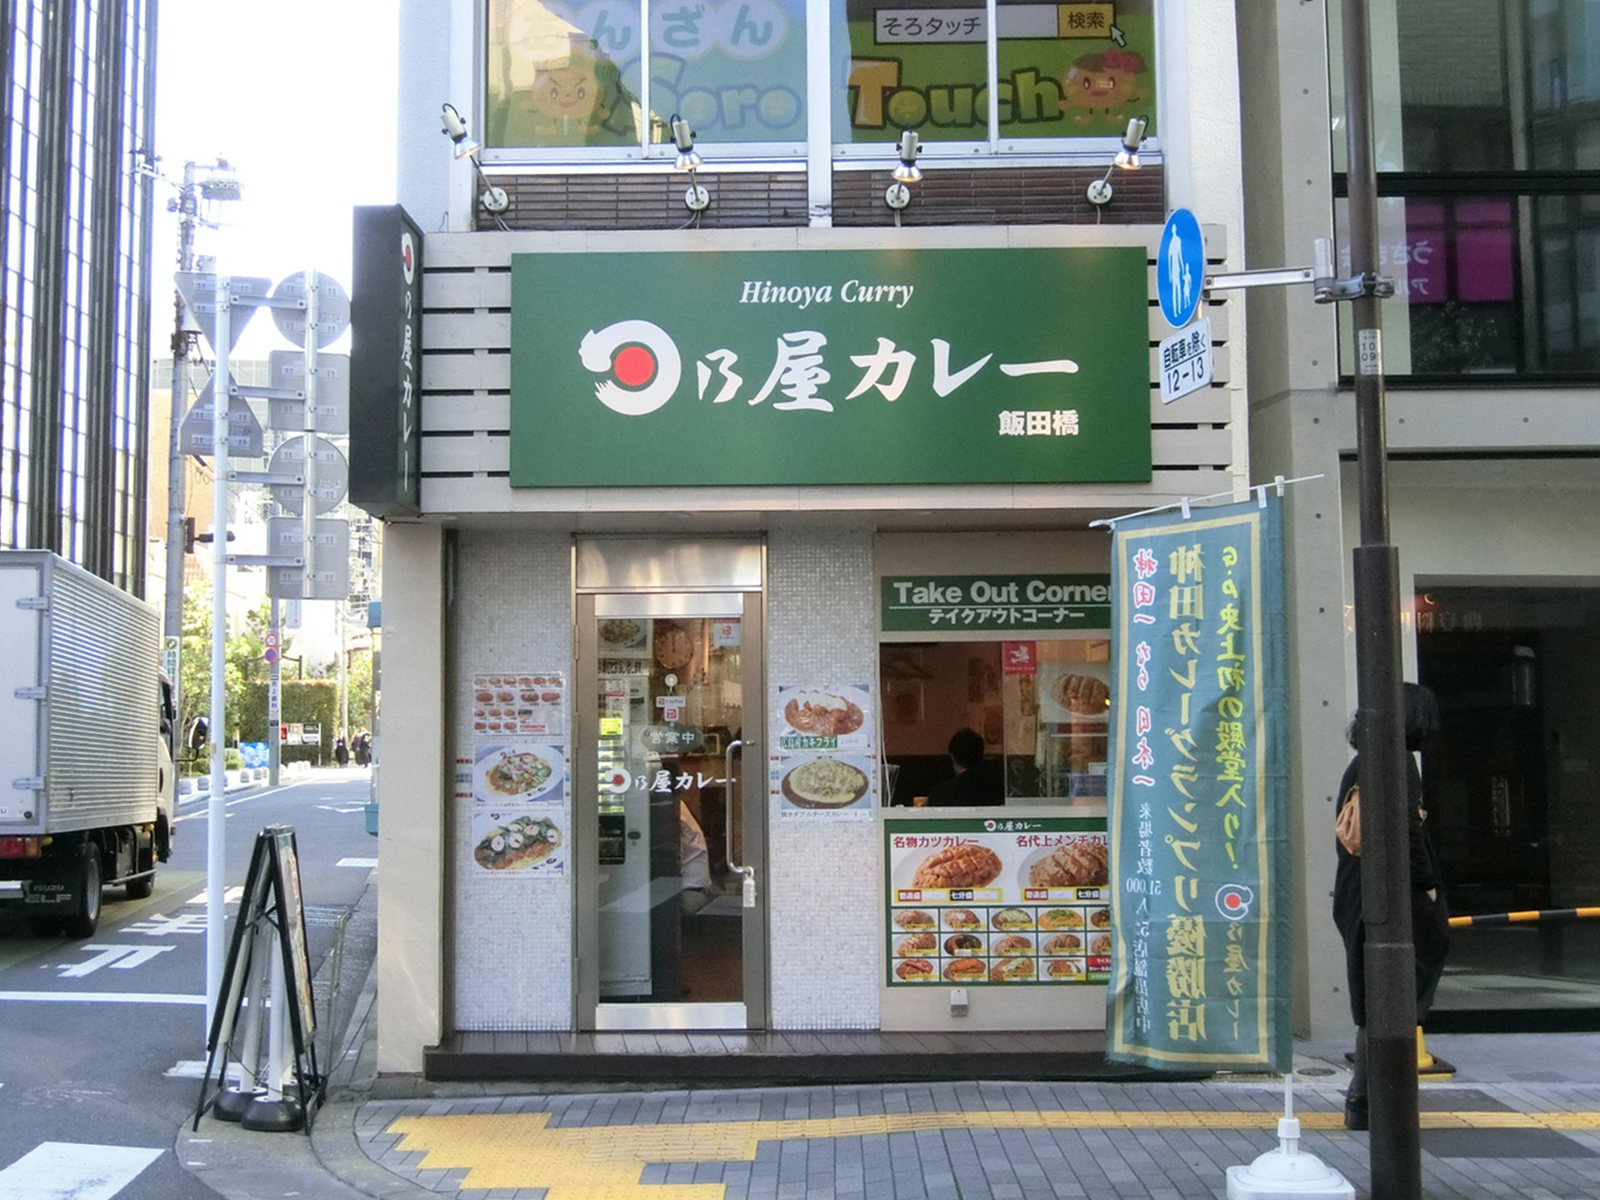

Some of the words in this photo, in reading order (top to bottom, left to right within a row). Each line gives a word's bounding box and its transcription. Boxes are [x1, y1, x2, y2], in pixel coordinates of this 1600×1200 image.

[882, 17, 982, 37] そろタッチ
[1067, 11, 1105, 29] 検索
[842, 54, 1064, 129] Touch
[739, 280, 833, 309] Hinoya
[840, 279, 915, 309] Curry
[1163, 331, 1206, 369] 自転車を除く
[1168, 356, 1204, 394] 12-13
[999, 410, 1080, 437] 飯田橋
[893, 582, 963, 604] Take
[970, 580, 1019, 603] Out
[929, 607, 1085, 624] テイクアウトコーナー
[649, 731, 695, 745] 営業中
[893, 836, 980, 848] 名物カツカレー
